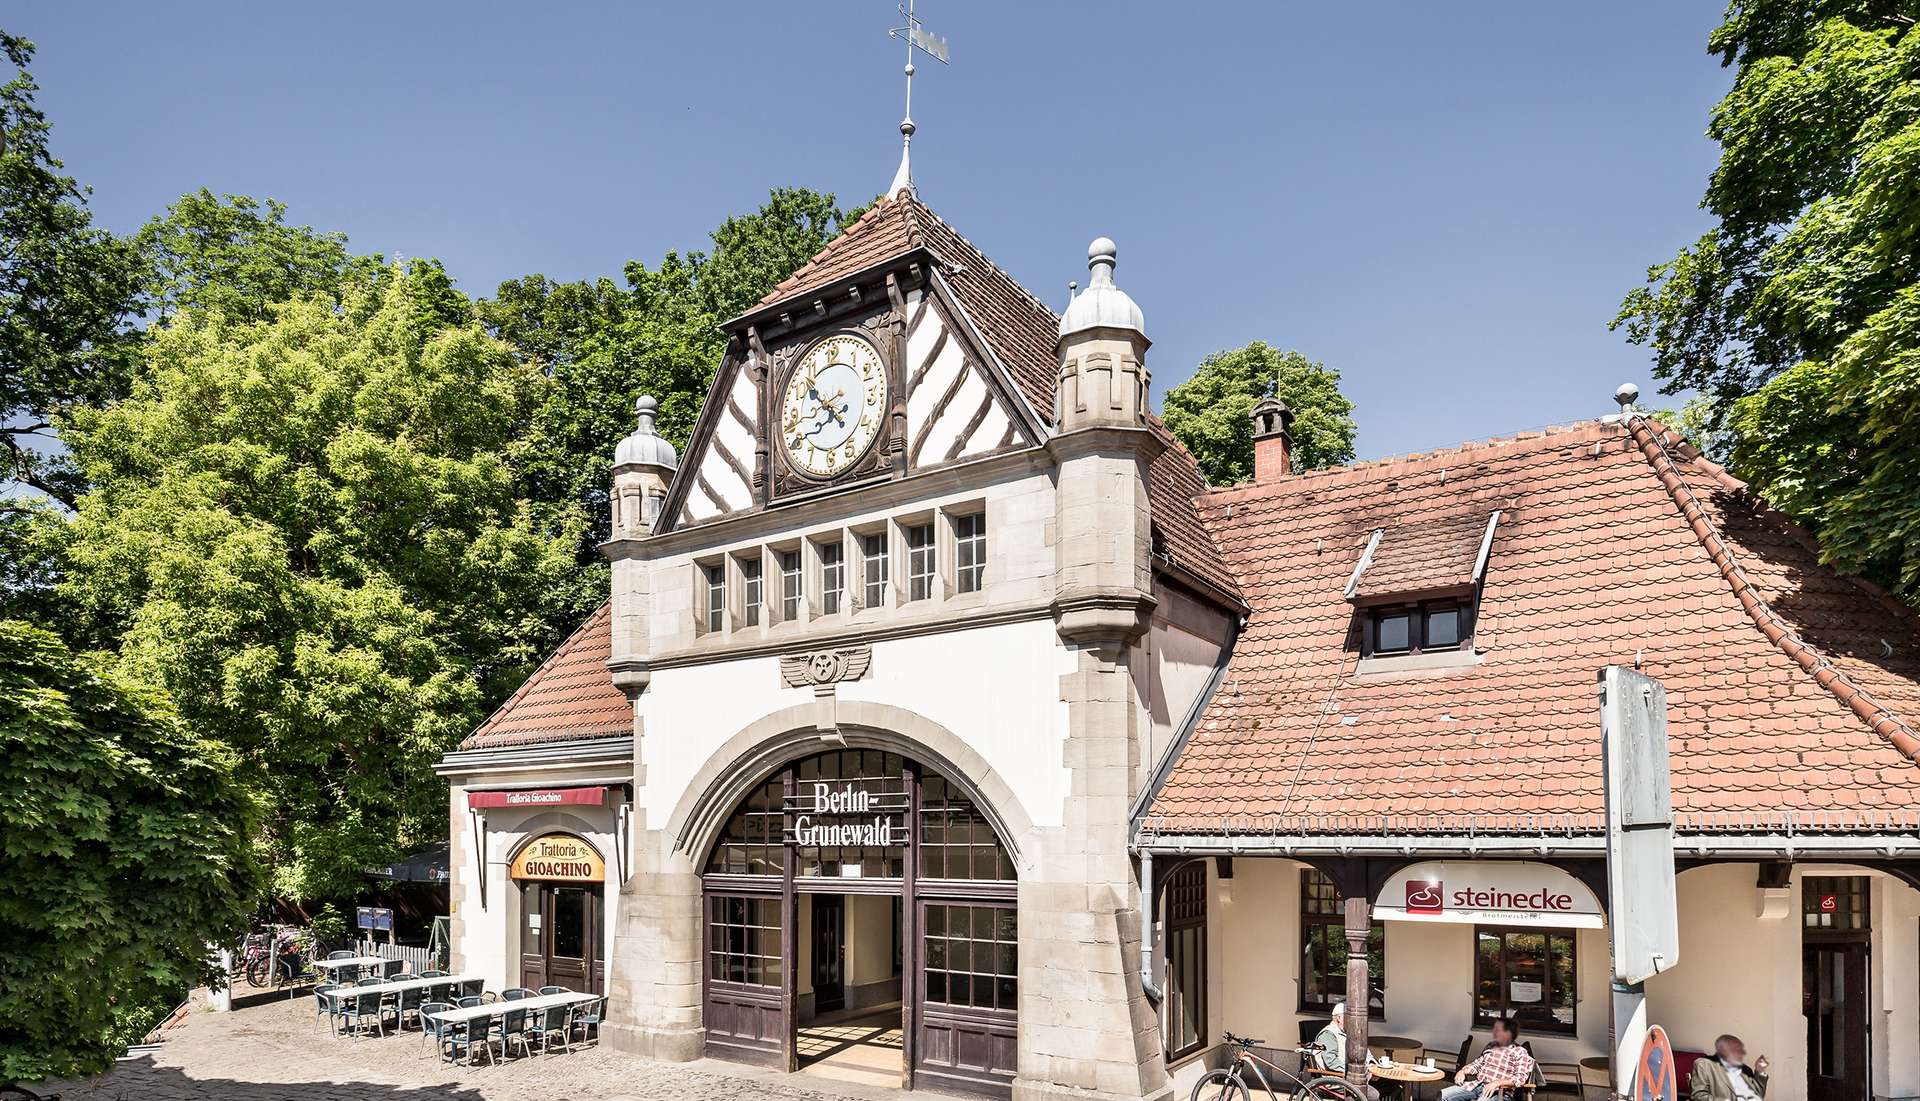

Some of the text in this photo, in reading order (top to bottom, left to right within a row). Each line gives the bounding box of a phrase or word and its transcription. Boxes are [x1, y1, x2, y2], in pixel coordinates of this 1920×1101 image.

[825, 344, 840, 364] 12
[863, 363, 874, 382] 2
[866, 385, 878, 406] 3
[506, 791, 562, 804] Trattoria Gioachino
[813, 782, 880, 814] Berlin-
[794, 815, 891, 847] Grunewald
[540, 842, 577, 857] Trattoria
[526, 861, 592, 877] GIOACHINO
[1453, 887, 1573, 910] steinecke
